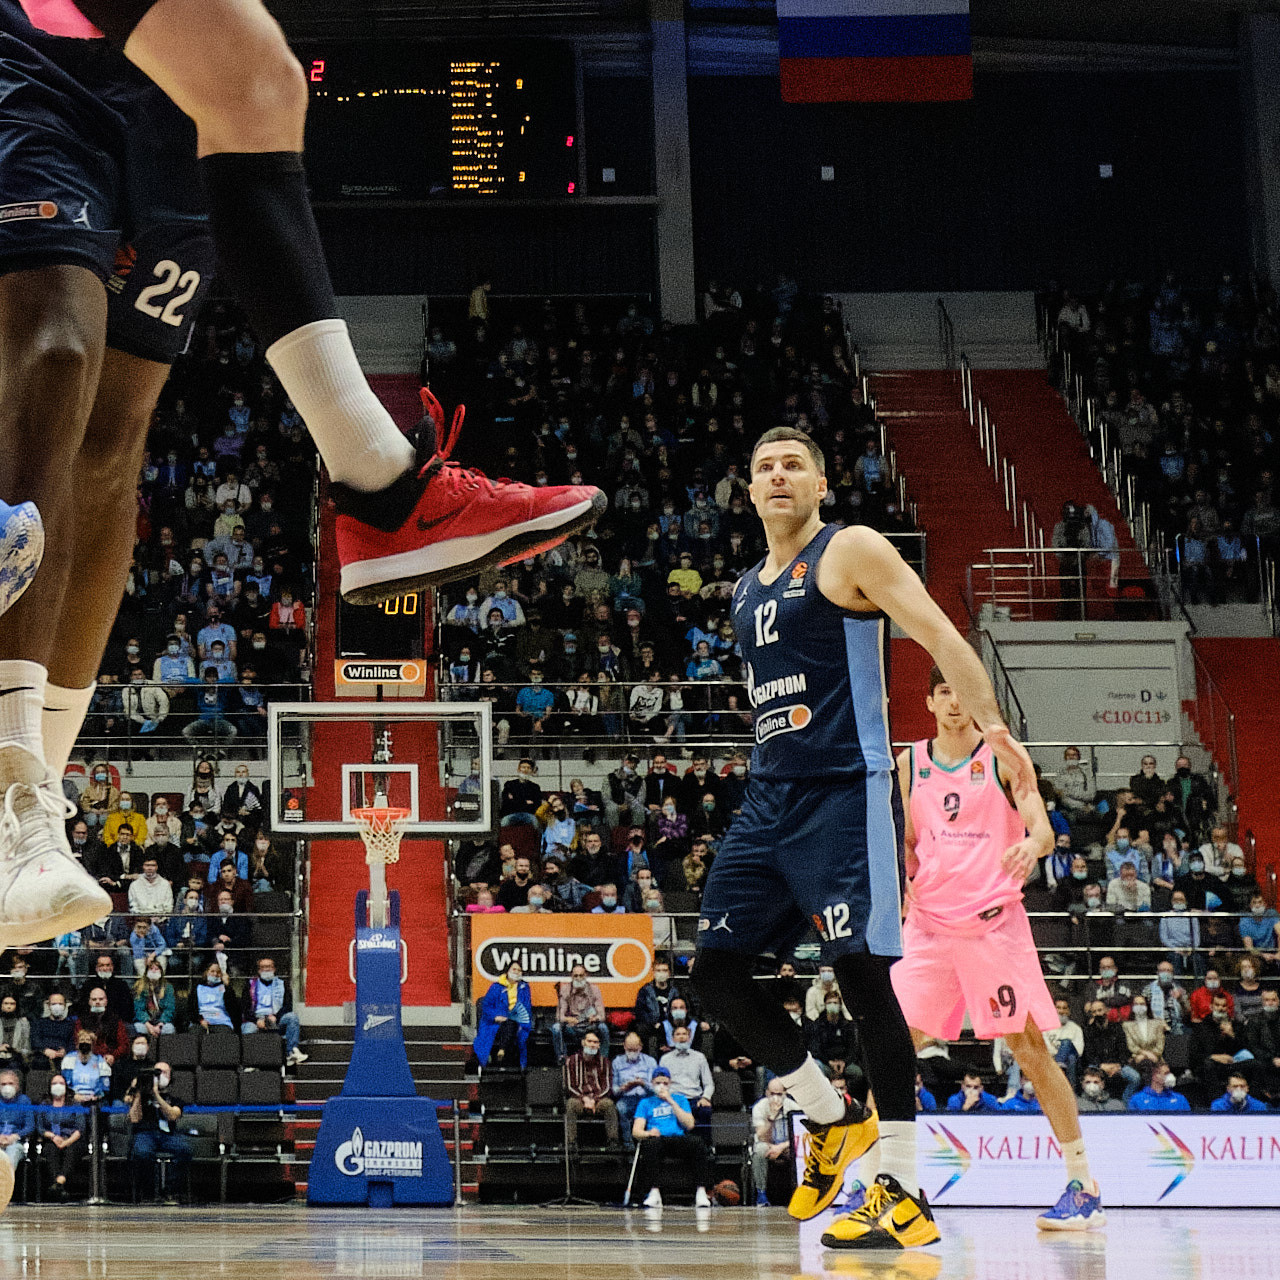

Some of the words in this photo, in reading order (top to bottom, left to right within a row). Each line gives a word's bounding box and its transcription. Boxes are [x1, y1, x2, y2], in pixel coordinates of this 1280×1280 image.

[134, 259, 201, 328] 22
[754, 599, 780, 648] 12
[348, 666, 398, 678] Winline
[757, 673, 807, 705] GAZPROM
[1140, 689, 1152, 703] D
[1102, 709, 1132, 724] C10
[1134, 709, 1162, 724] C11
[943, 792, 961, 822] 9
[822, 902, 853, 941] 12
[491, 947, 601, 973] Winline
[997, 984, 1017, 1018] 9
[363, 1141, 423, 1158] GAZPROM
